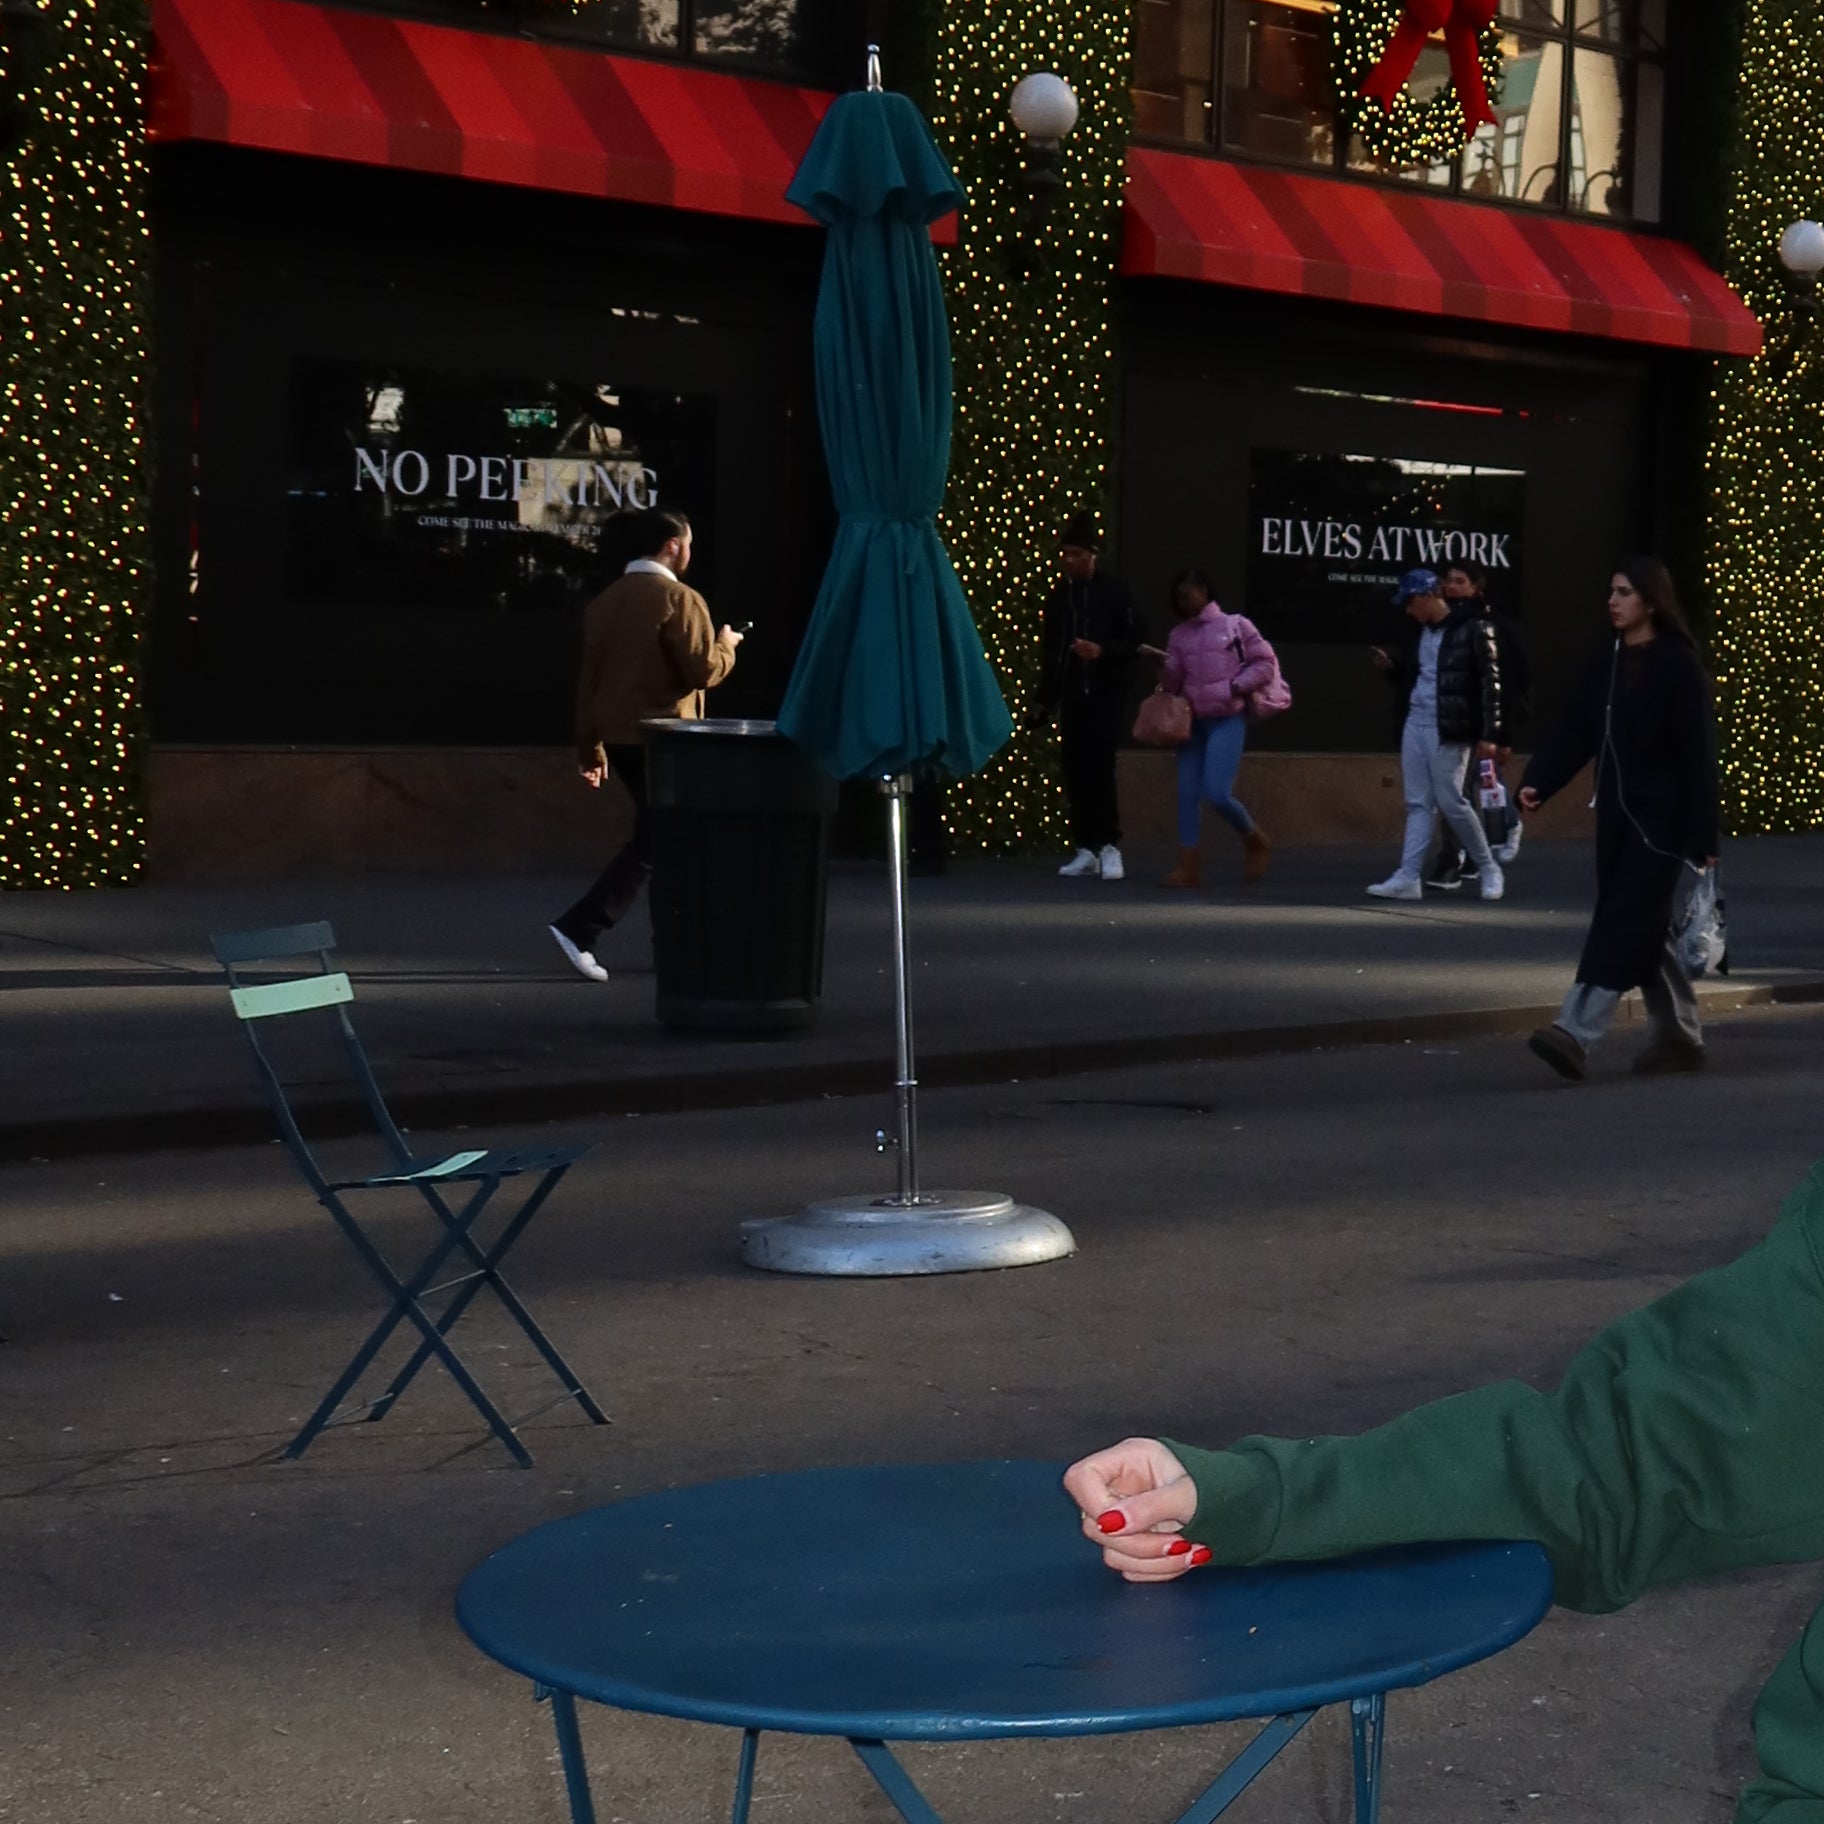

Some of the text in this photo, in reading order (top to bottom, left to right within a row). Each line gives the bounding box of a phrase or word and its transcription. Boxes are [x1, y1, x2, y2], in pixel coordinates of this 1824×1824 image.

[354, 447, 660, 510] NO PEEKING
[1261, 518, 1511, 568] ELVES AT WORK
